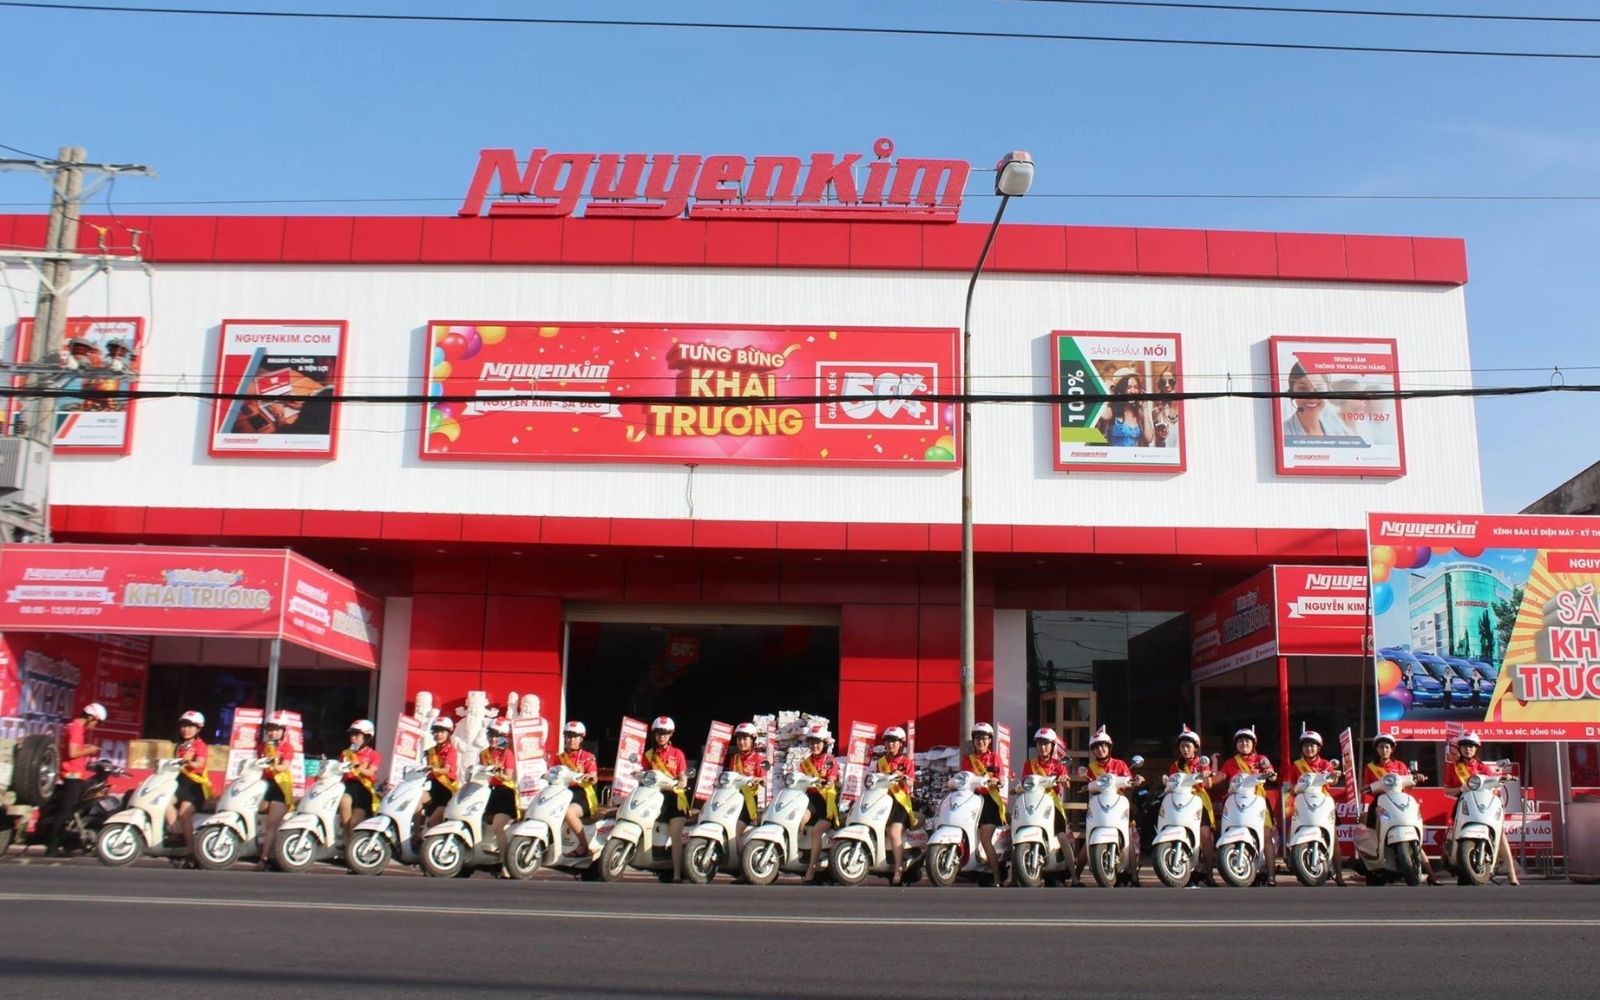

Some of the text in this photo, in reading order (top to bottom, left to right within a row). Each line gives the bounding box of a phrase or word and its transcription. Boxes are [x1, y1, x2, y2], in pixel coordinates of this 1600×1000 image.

[458, 137, 971, 224] NguyenKim
[234, 334, 332, 344] NGUYENKIM.COM
[1143, 344, 1168, 357] MỚI
[479, 360, 611, 383] NguyenKim
[690, 368, 777, 399] KHAI
[825, 391, 838, 419] GIẢ
[650, 403, 804, 437] TRƯƠNG
[1343, 412, 1390, 422] 1900 1267
[1380, 520, 1477, 539] NguyenKim
[1347, 603, 1365, 611] KIM
